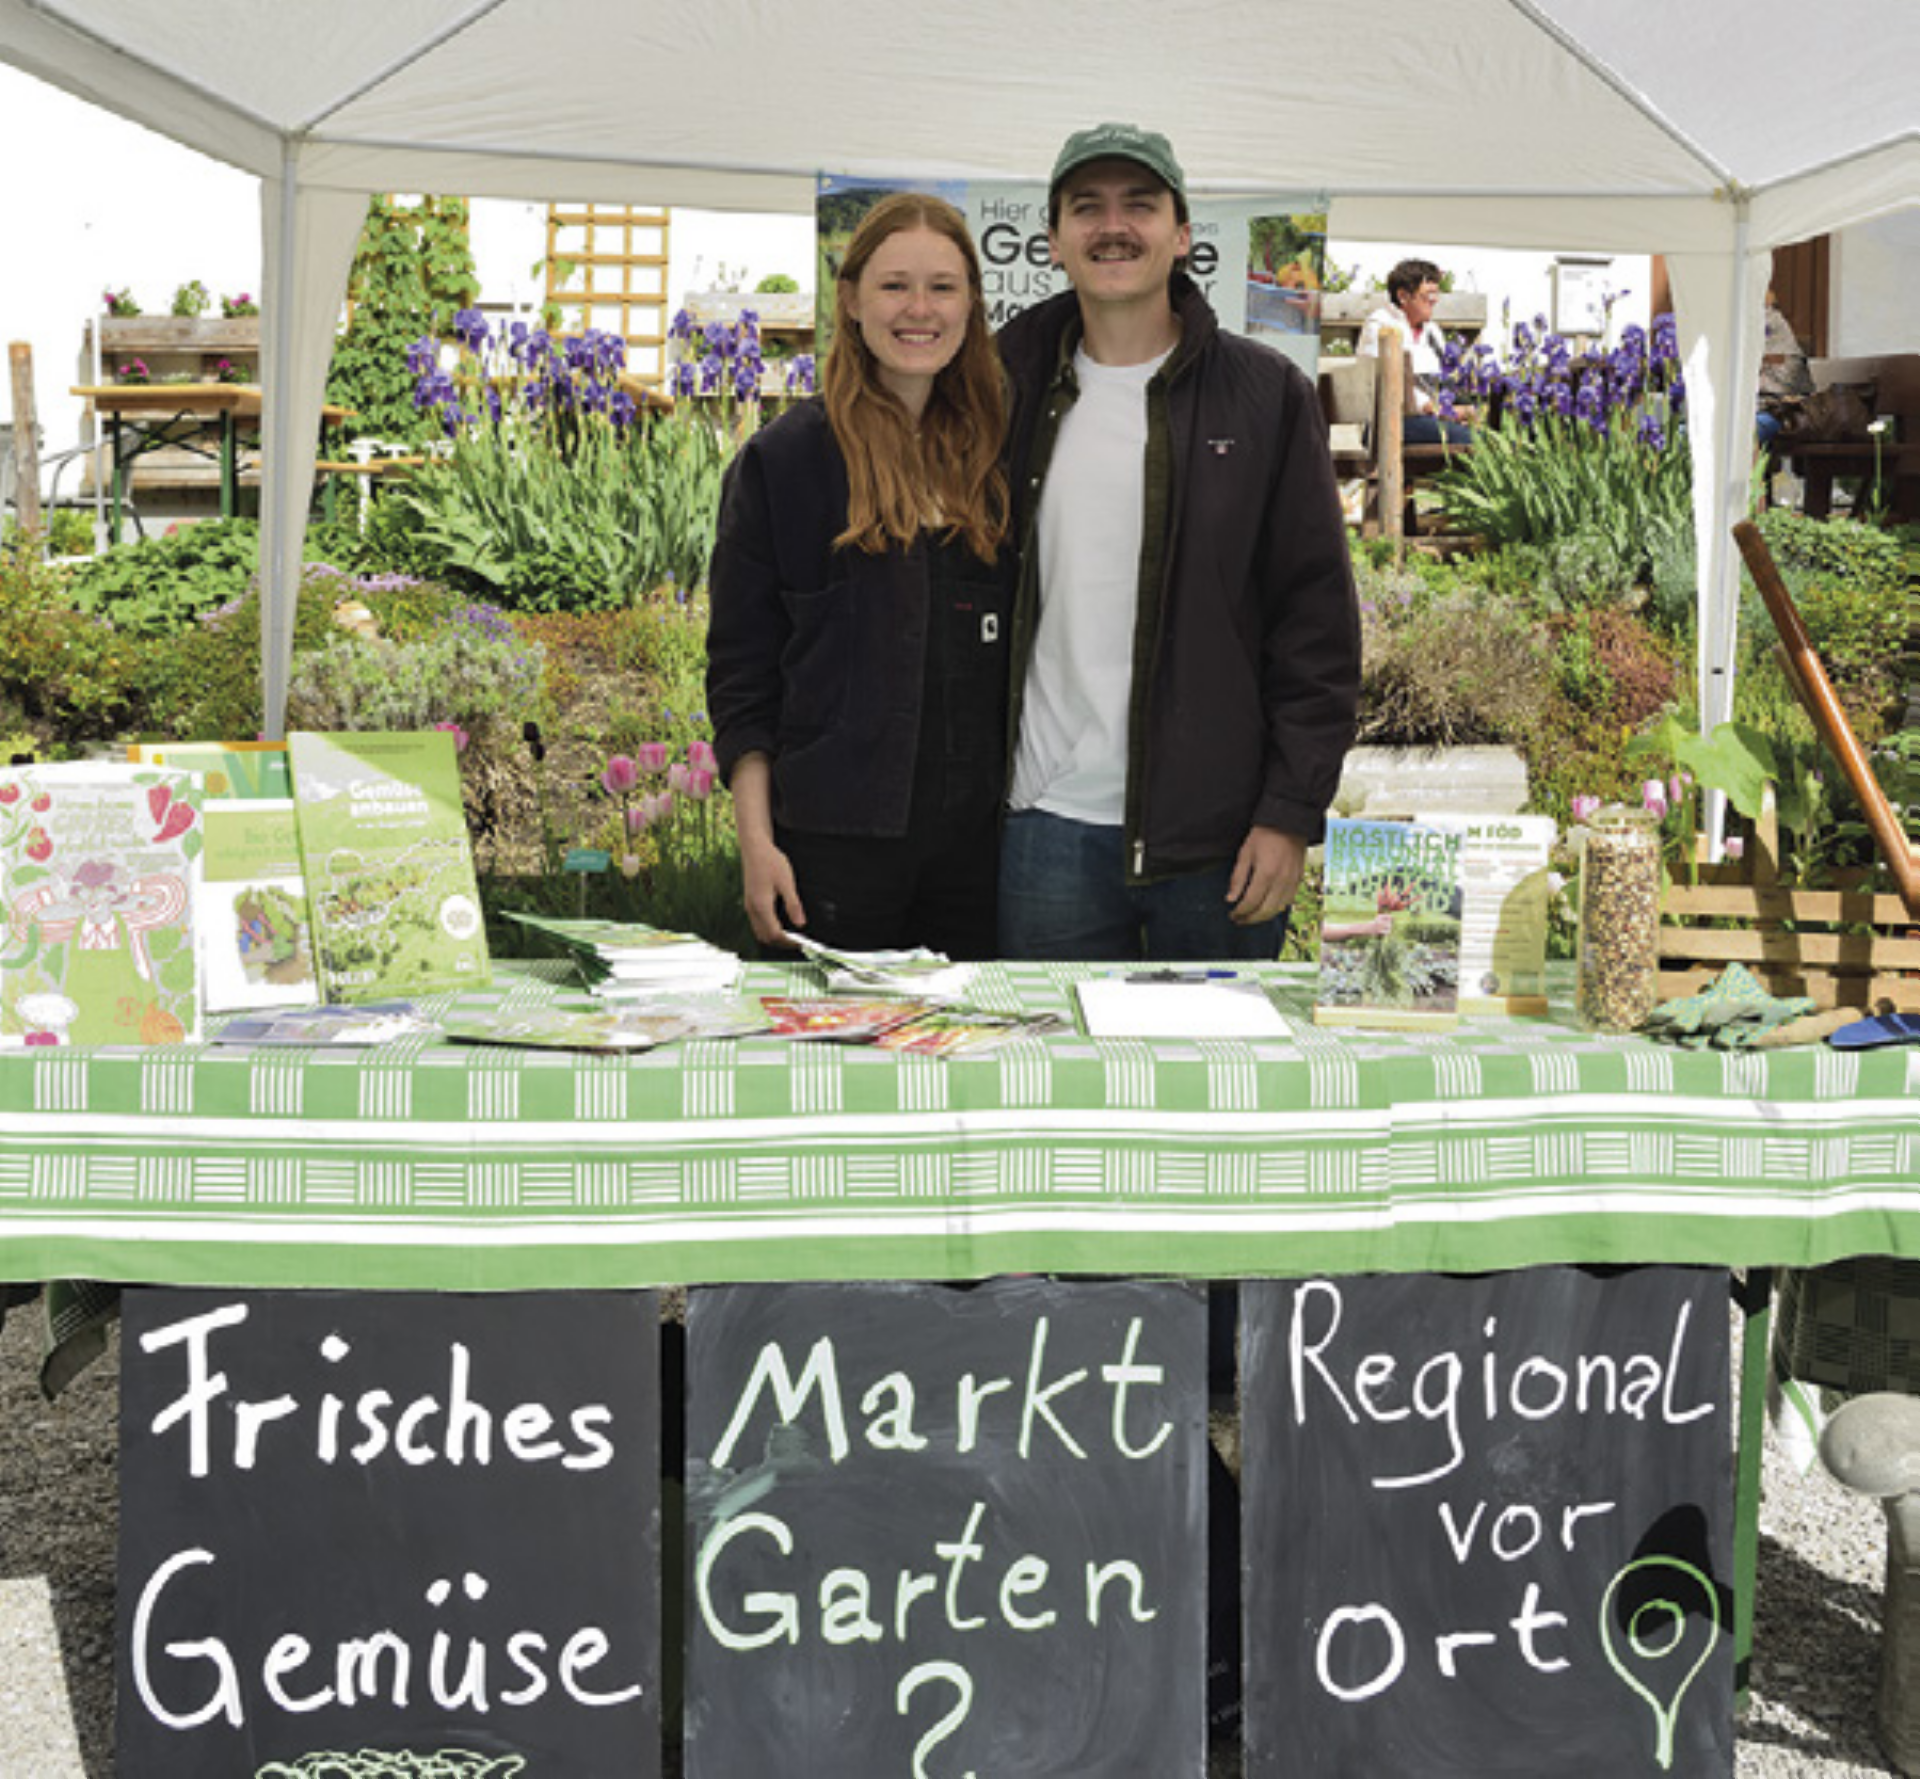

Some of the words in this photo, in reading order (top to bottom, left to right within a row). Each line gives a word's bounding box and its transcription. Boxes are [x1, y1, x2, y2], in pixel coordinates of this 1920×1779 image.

[981, 199, 1033, 221] Hier
[982, 270, 1052, 297] aus
[139, 1303, 614, 1478] Frisches
[711, 1316, 1174, 1468] Markt
[696, 1502, 1160, 1650] Garten
[1438, 1500, 1616, 1563] vor
[133, 1546, 643, 1730] Gemüse
[1316, 1582, 1571, 1701] Ort
